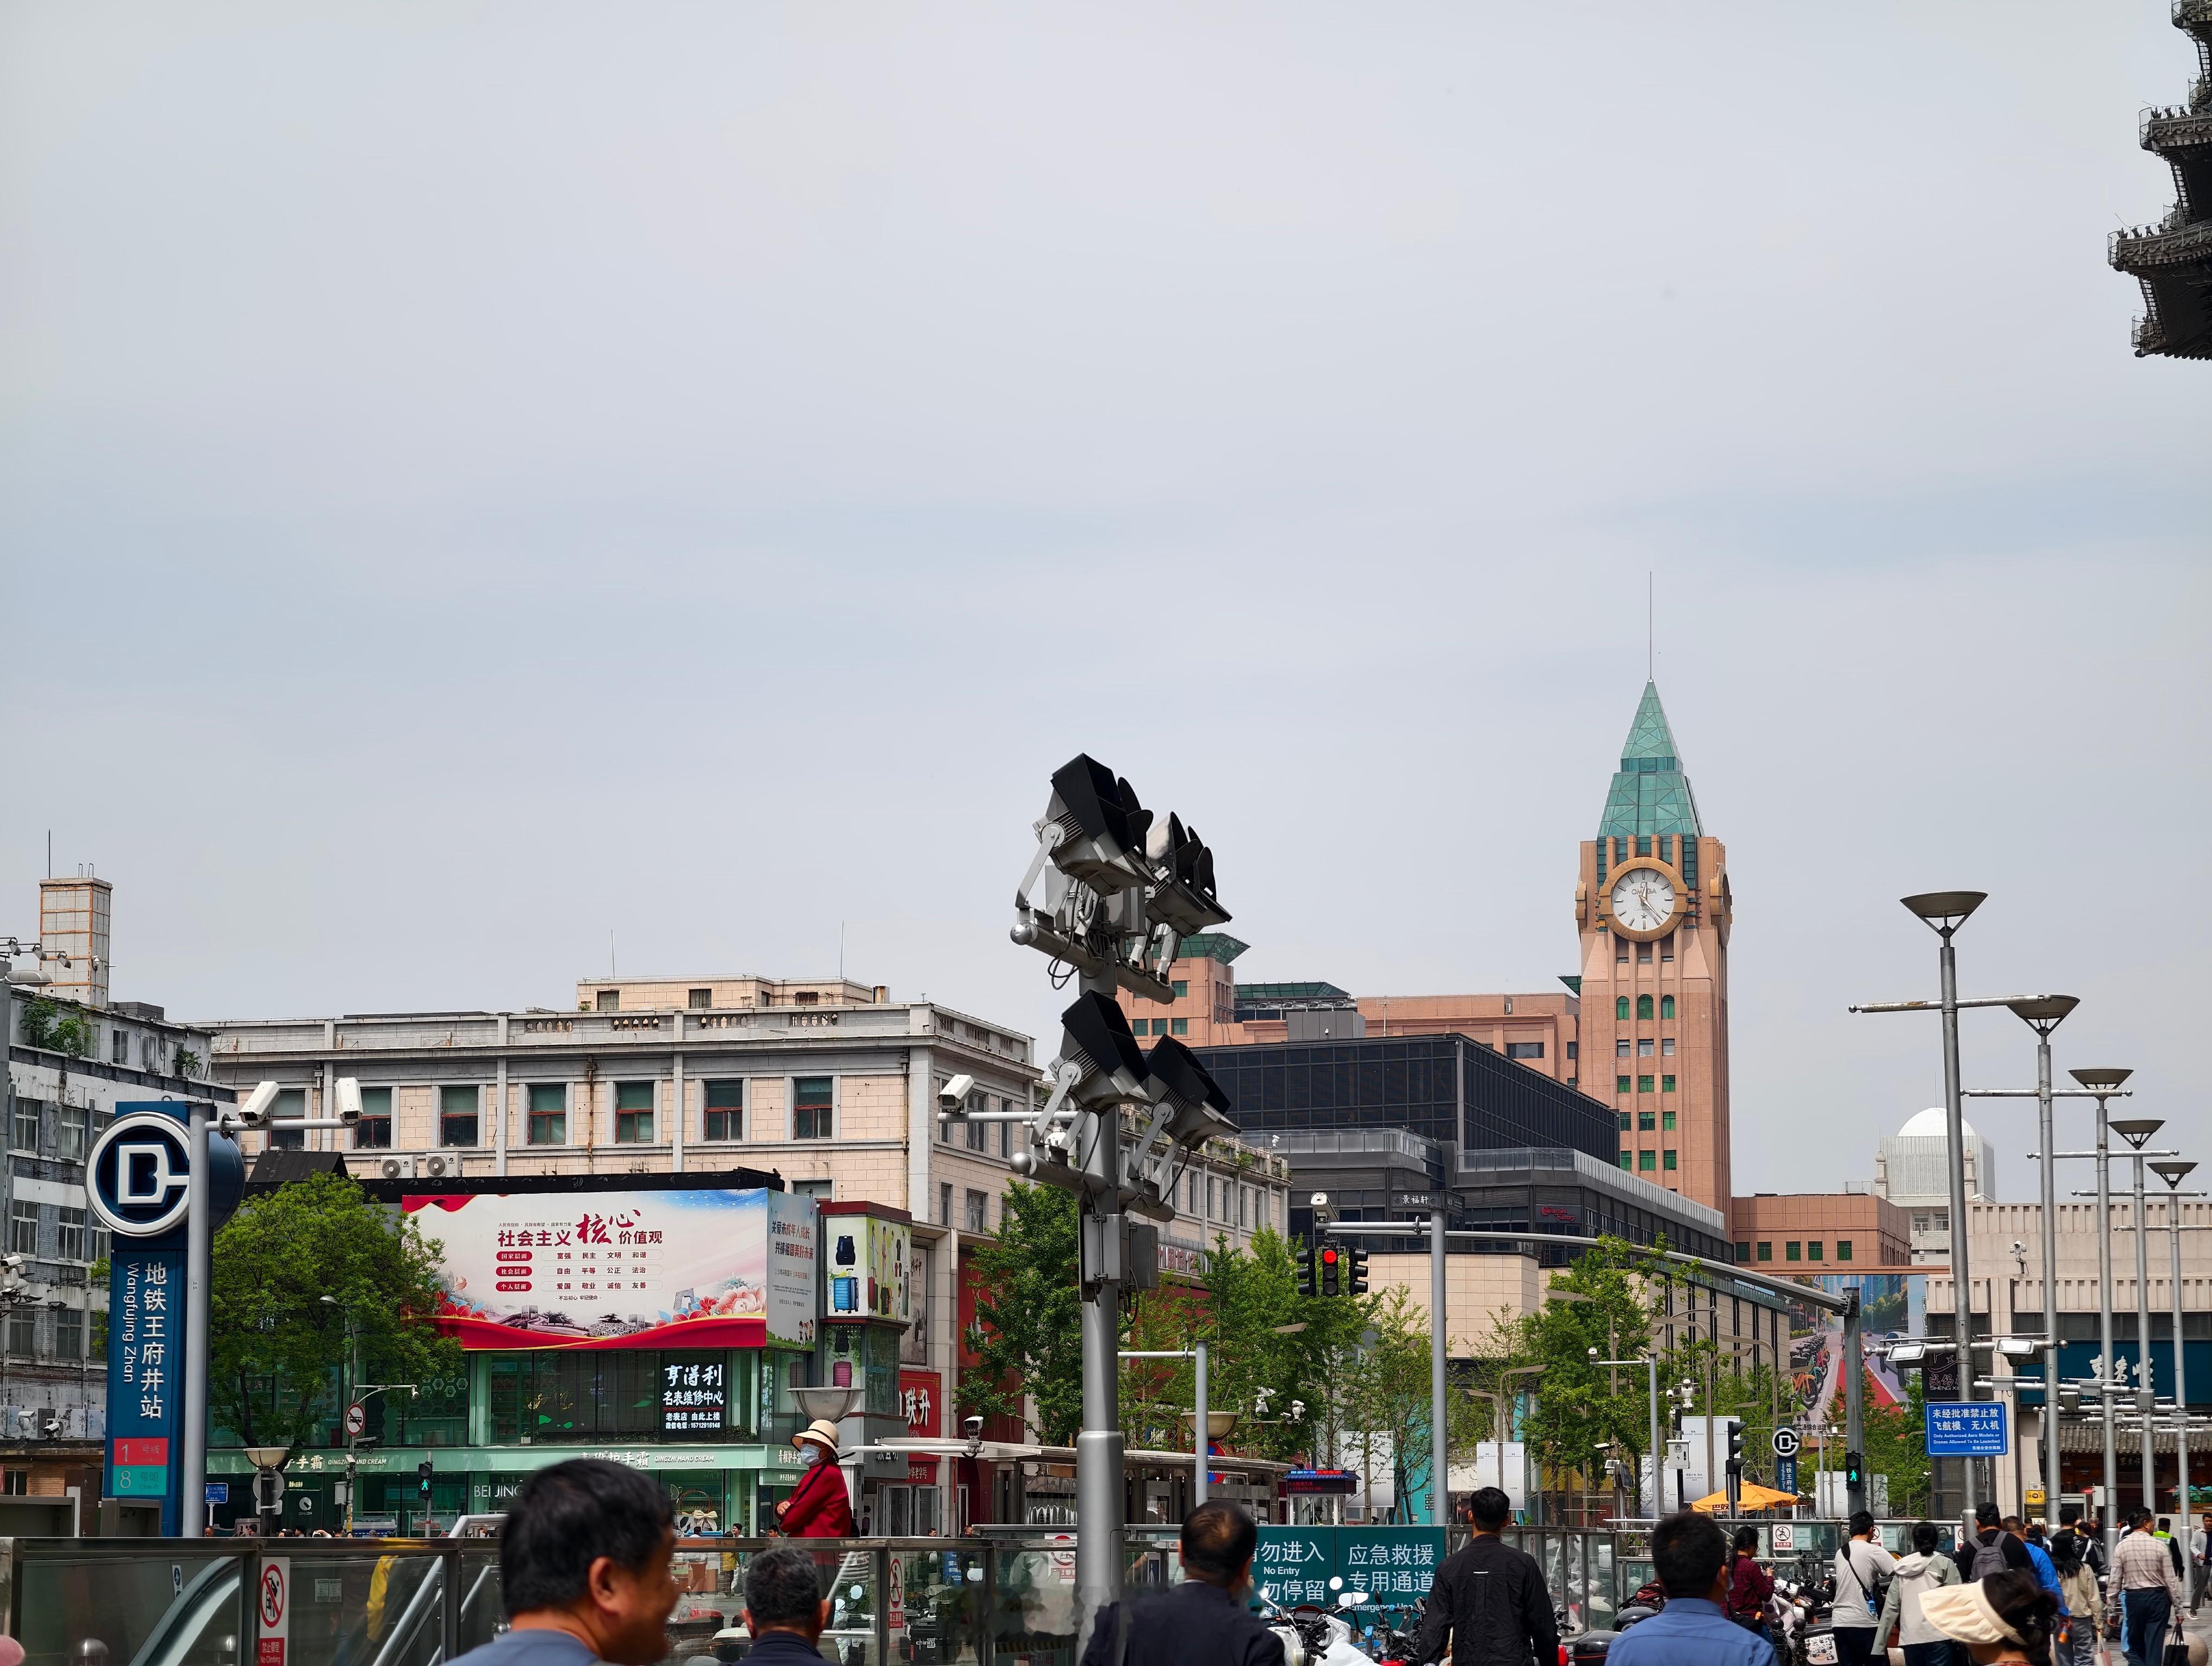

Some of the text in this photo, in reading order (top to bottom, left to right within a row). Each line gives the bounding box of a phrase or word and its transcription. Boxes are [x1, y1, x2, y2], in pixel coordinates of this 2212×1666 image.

[1401, 1195, 1429, 1204] 景福轩
[771, 1220, 810, 1240] 关爱未成年人成长
[775, 1241, 814, 1260] 共铸祖国美好未来
[122, 1263, 139, 1382] Wangfujing Zhan
[140, 1261, 168, 1419] 地铁王府井站
[665, 1364, 723, 1387] 亨得利
[1928, 1373, 1959, 1386] 盛锡
[663, 1390, 724, 1406] 名表维修中心
[665, 1412, 721, 1421] 老表店 由此上楼
[1932, 1408, 1998, 1419] 未经批准禁止放
[1932, 1420, 1999, 1431] 飞航模、无人机
[121, 1444, 128, 1463] 1
[143, 1444, 159, 1454] 号线
[120, 1470, 131, 1489] 8
[1348, 1543, 1435, 1566] 应急救援
[1263, 1566, 1300, 1576] No Entry
[1263, 1579, 1325, 1601] 勿停留
[1348, 1570, 1435, 1593] 专用通道
[266, 1656, 281, 1665] Climbing
